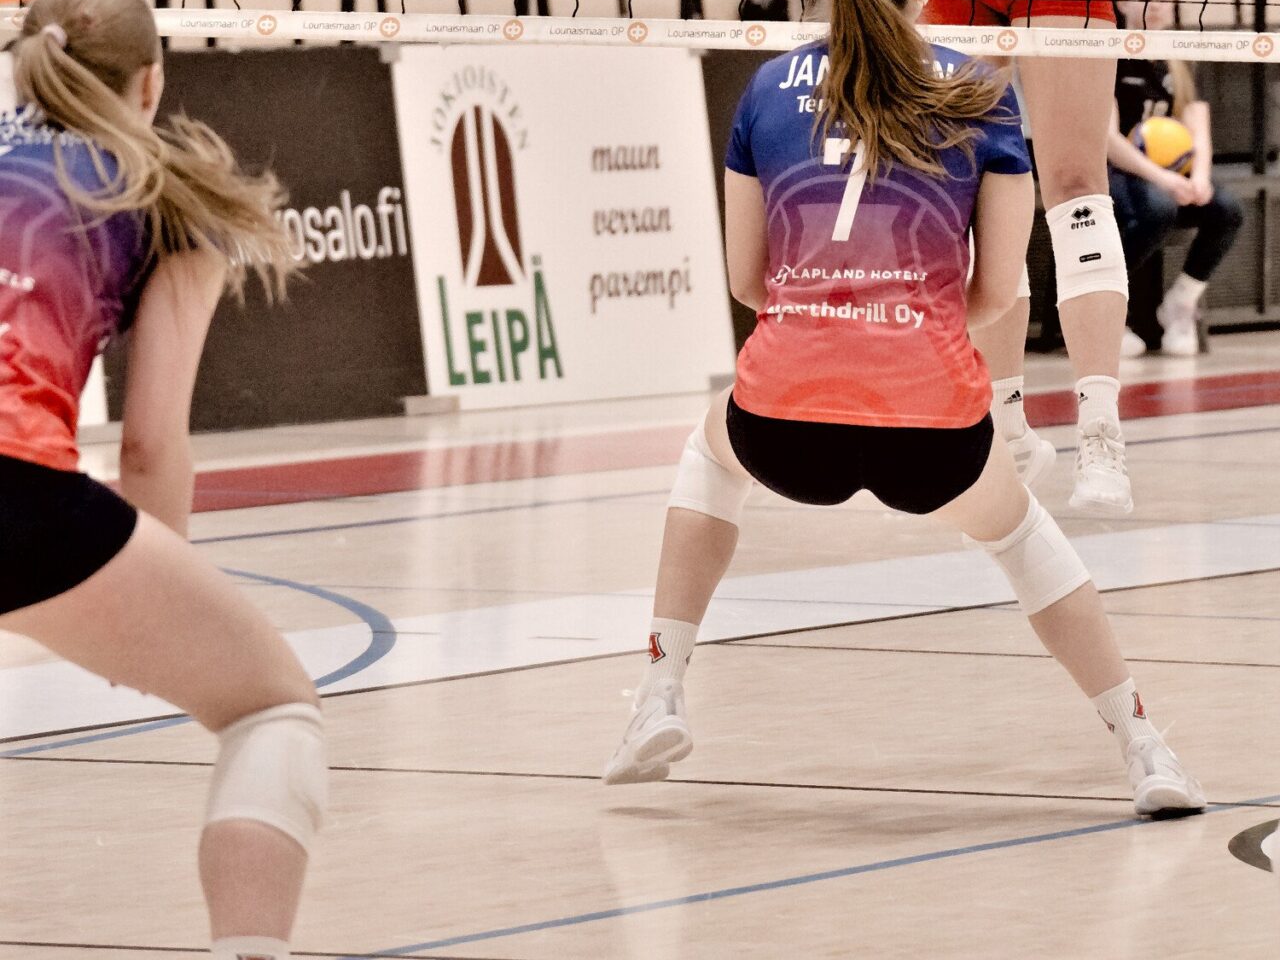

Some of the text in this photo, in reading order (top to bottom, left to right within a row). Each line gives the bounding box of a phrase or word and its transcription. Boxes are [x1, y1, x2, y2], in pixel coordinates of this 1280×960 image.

[179, 18, 254, 29] Lounaismaan OP
[302, 21, 377, 31] Lounaismaan OP
[425, 23, 500, 34] Lounaismaan OP
[549, 26, 625, 36] Lounaismaan OP
[667, 29, 743, 39] Lounaismaan OP
[980, 35, 994, 44] OP
[1044, 37, 1122, 48] Lounaismaan OP
[1172, 40, 1250, 50] Lounaismaan OP
[430, 64, 531, 153] JOKIOISTEN
[591, 144, 660, 172] maun
[823, 137, 868, 243] 7
[593, 206, 672, 237] verran
[791, 267, 929, 282] LAPLAND HOTELS
[589, 255, 693, 315] parempi
[437, 253, 565, 387] LEIPÄ
[894, 303, 925, 329] Oy
